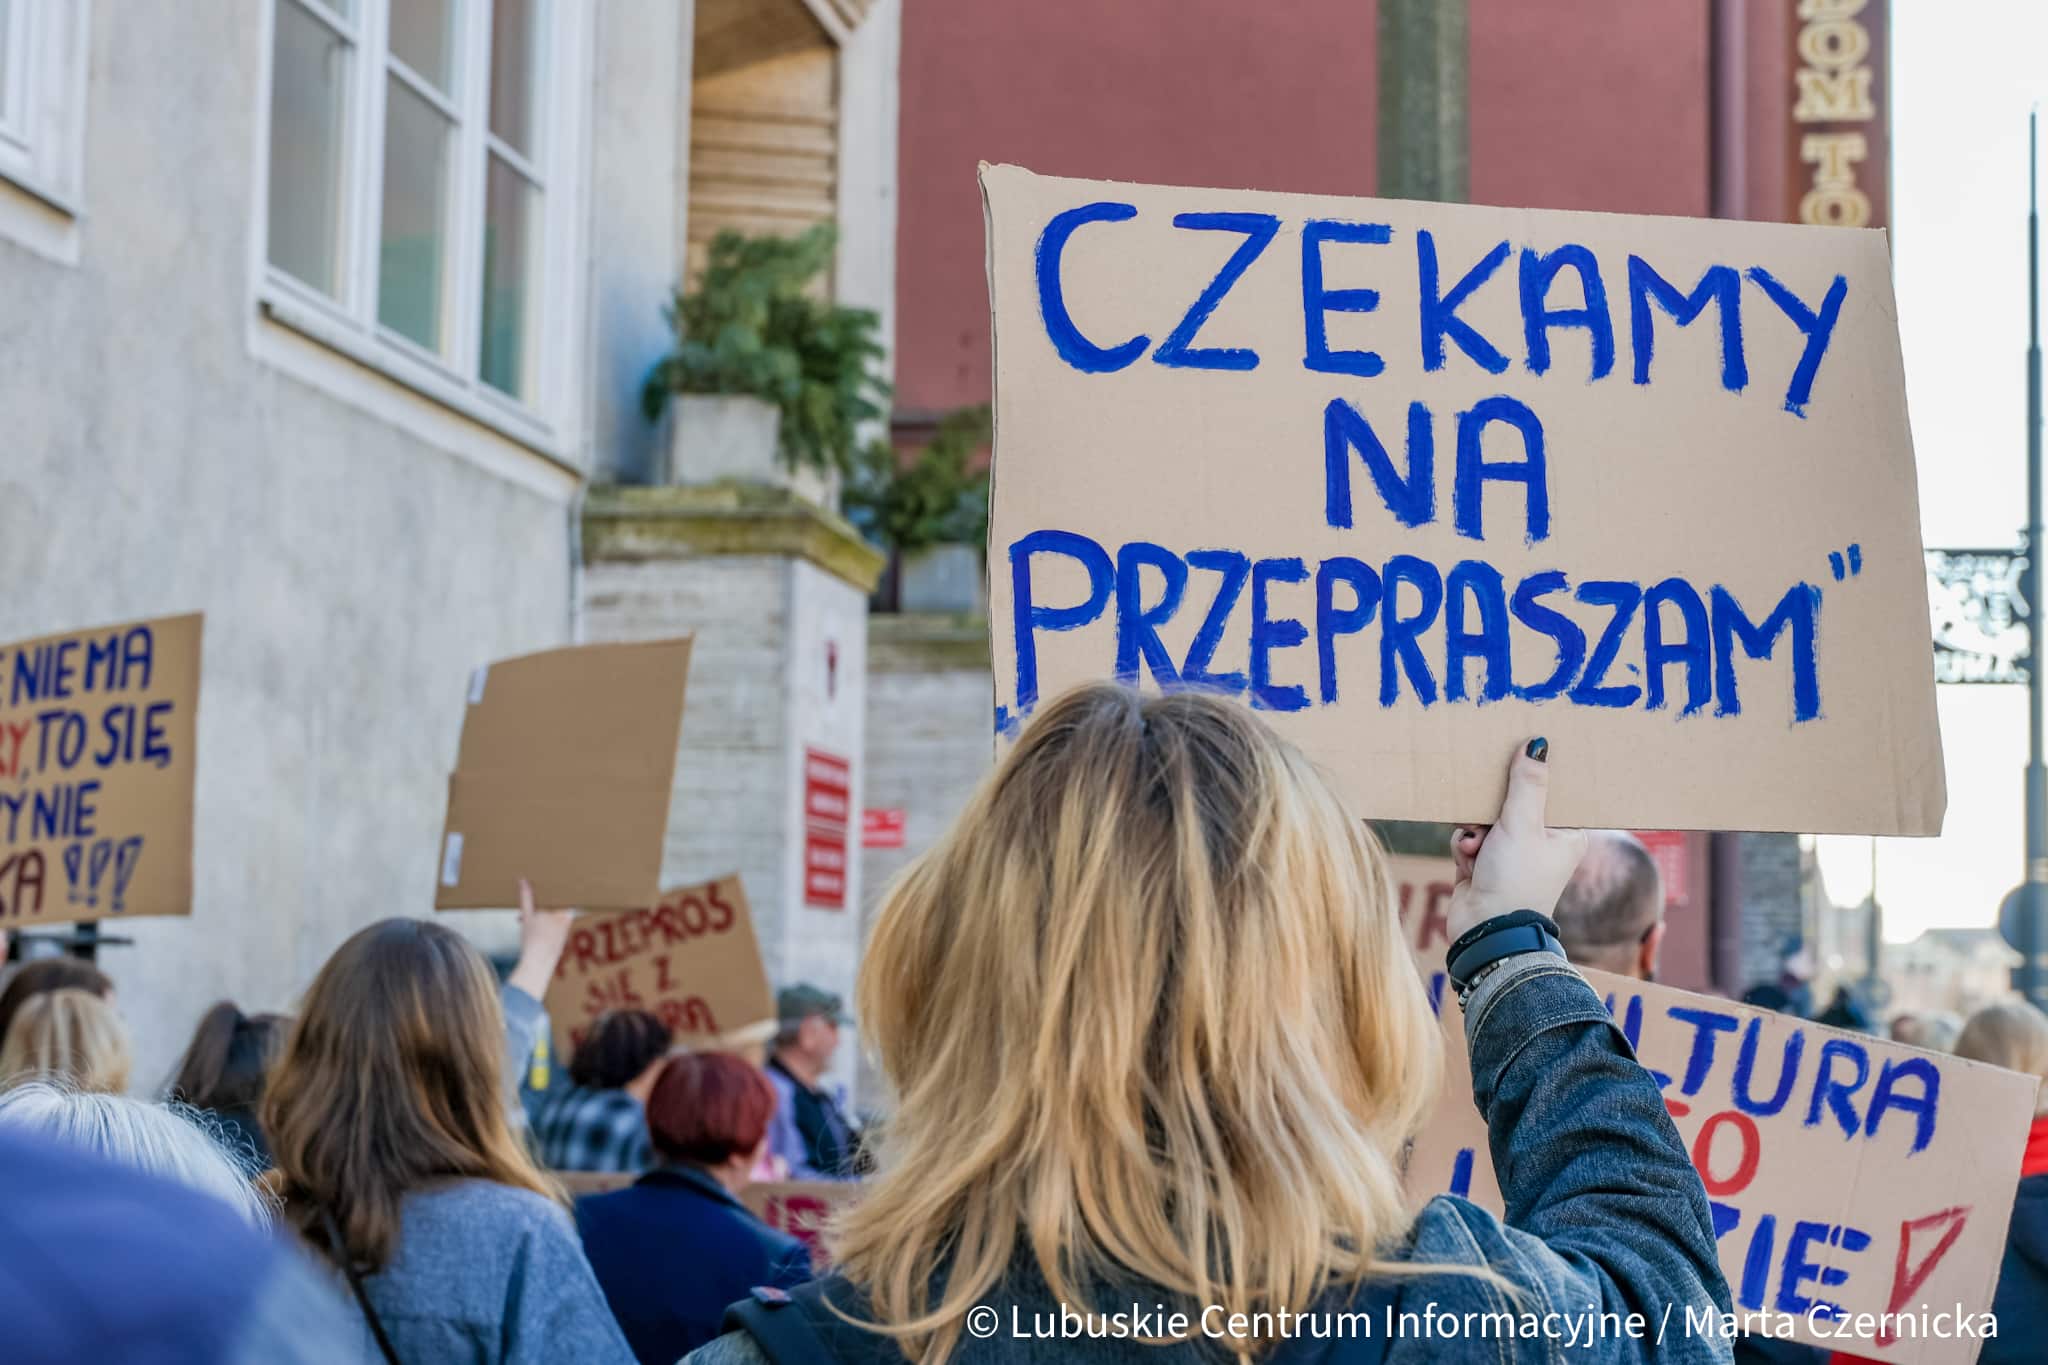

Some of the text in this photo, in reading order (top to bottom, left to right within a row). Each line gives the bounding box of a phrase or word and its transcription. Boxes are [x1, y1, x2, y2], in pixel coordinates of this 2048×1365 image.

[1034, 202, 1848, 418] CZEKAMY
[1324, 396, 1549, 543] NA
[37, 709, 87, 773] TO
[94, 700, 174, 769] SIĘ
[31, 781, 101, 841] NIE
